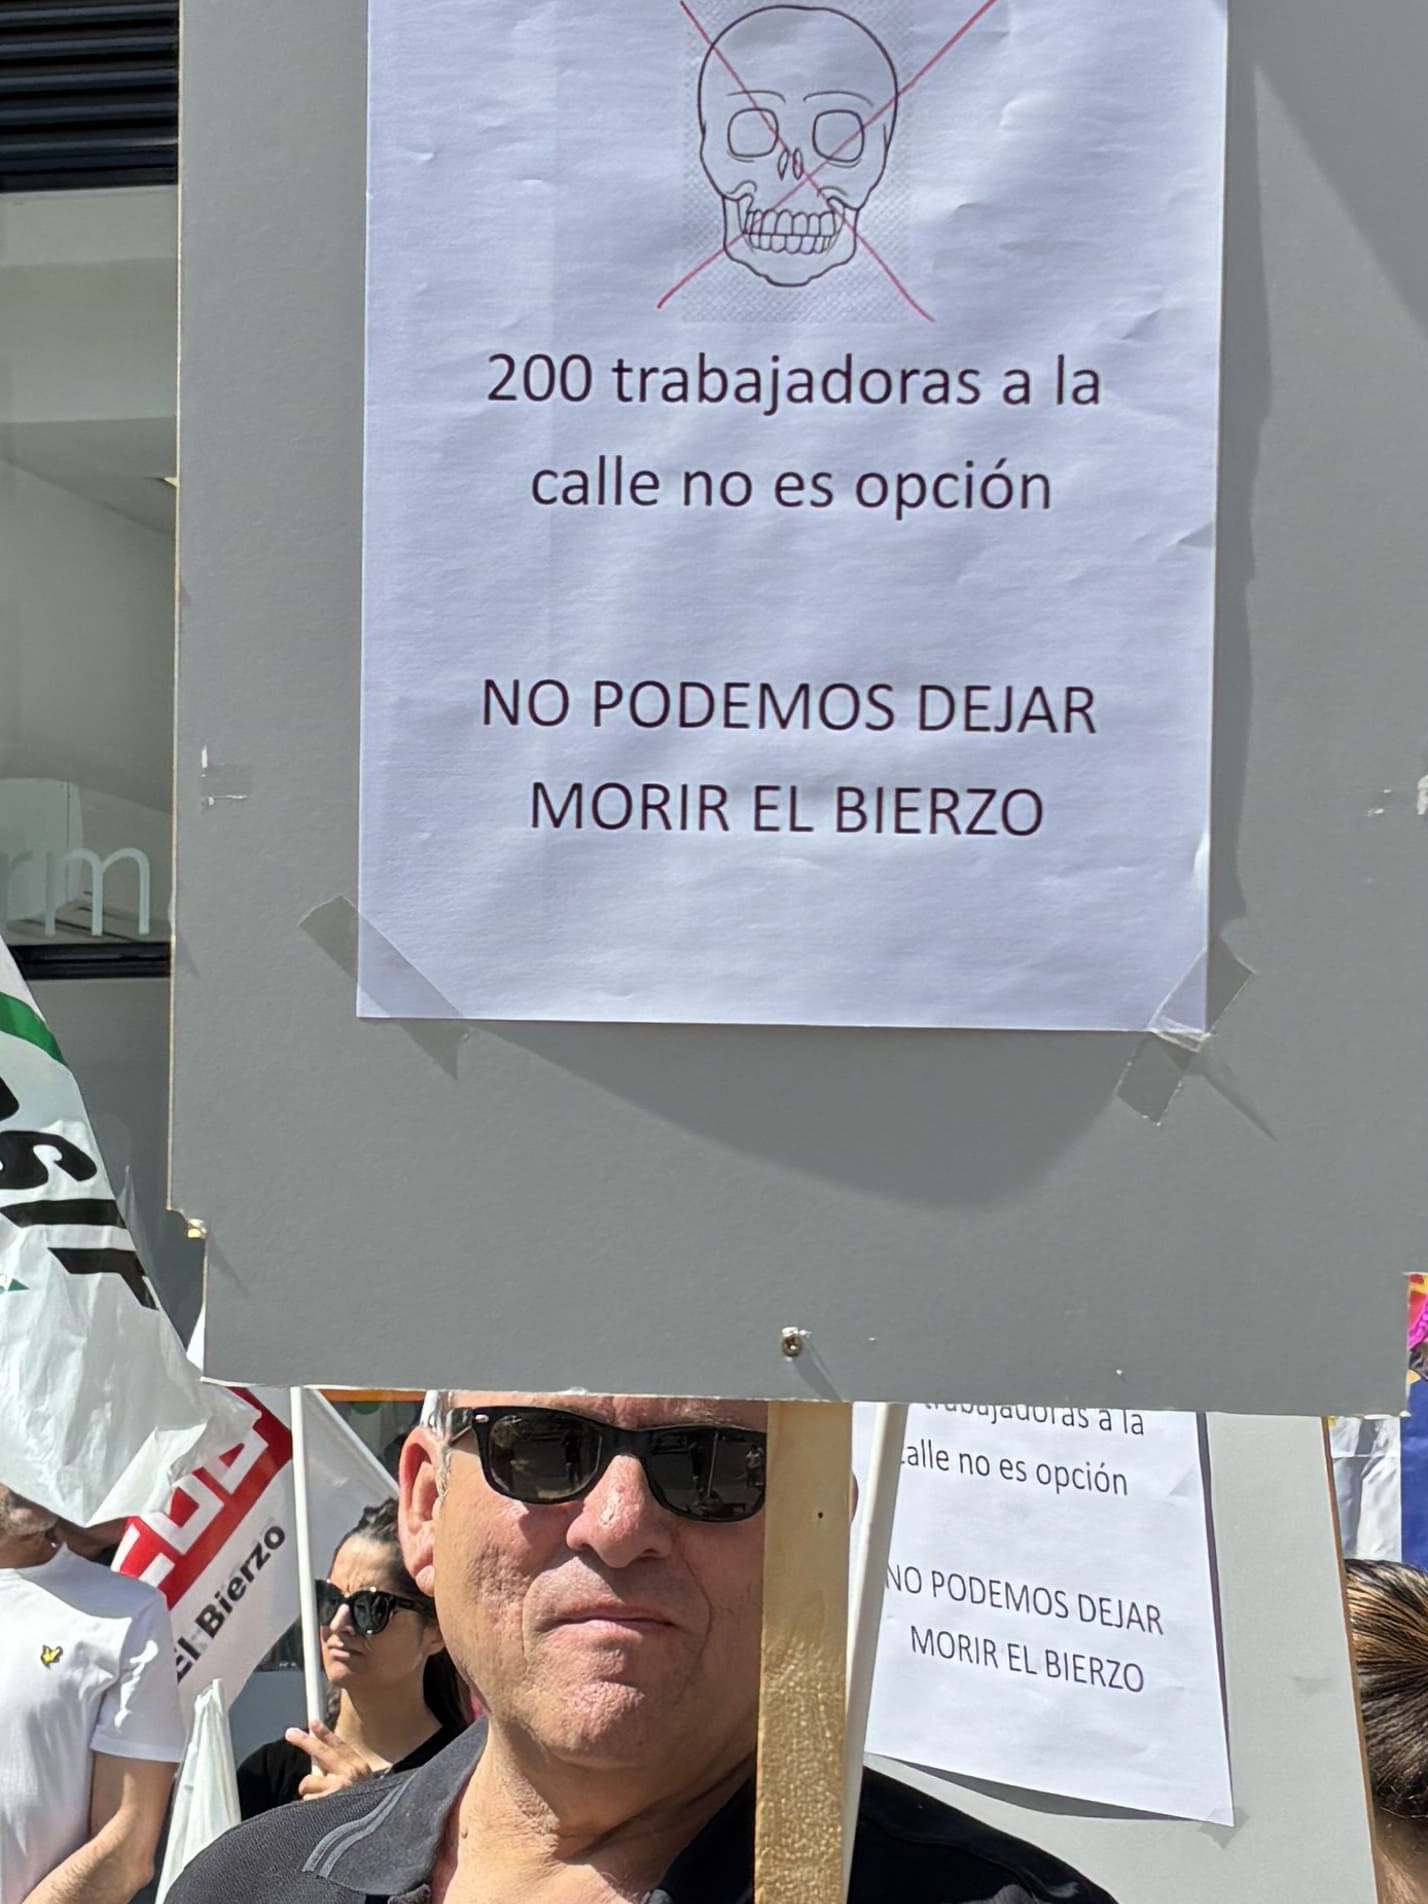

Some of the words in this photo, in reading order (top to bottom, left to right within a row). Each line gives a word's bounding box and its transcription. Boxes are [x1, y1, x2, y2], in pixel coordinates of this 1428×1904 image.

[489, 354, 591, 401] 200
[612, 353, 979, 415] trabajadoras
[1004, 370, 1029, 404] a
[1058, 355, 1099, 404] la
[533, 455, 659, 505] calle
[685, 471, 752, 506] no
[776, 472, 832, 507] es
[856, 458, 1049, 520] opción
[484, 679, 568, 726] NO
[595, 681, 894, 730] PODEMOS
[920, 685, 1096, 733] DEJAR
[533, 783, 728, 831] MORIR
[755, 786, 813, 831] EL
[838, 787, 1042, 836] BIERZO
[900, 1439, 950, 1472] alle
[959, 1452, 991, 1477] no
[1000, 1458, 1028, 1482] es
[1036, 1461, 1128, 1496] opción
[195, 1525, 287, 1640] Bierzo
[932, 1570, 1069, 1619] PODEMOS
[1078, 1594, 1164, 1635] DEJAR
[910, 1626, 999, 1669] MORIR
[1007, 1643, 1038, 1676] EL
[1045, 1649, 1145, 1693] BIERZO
